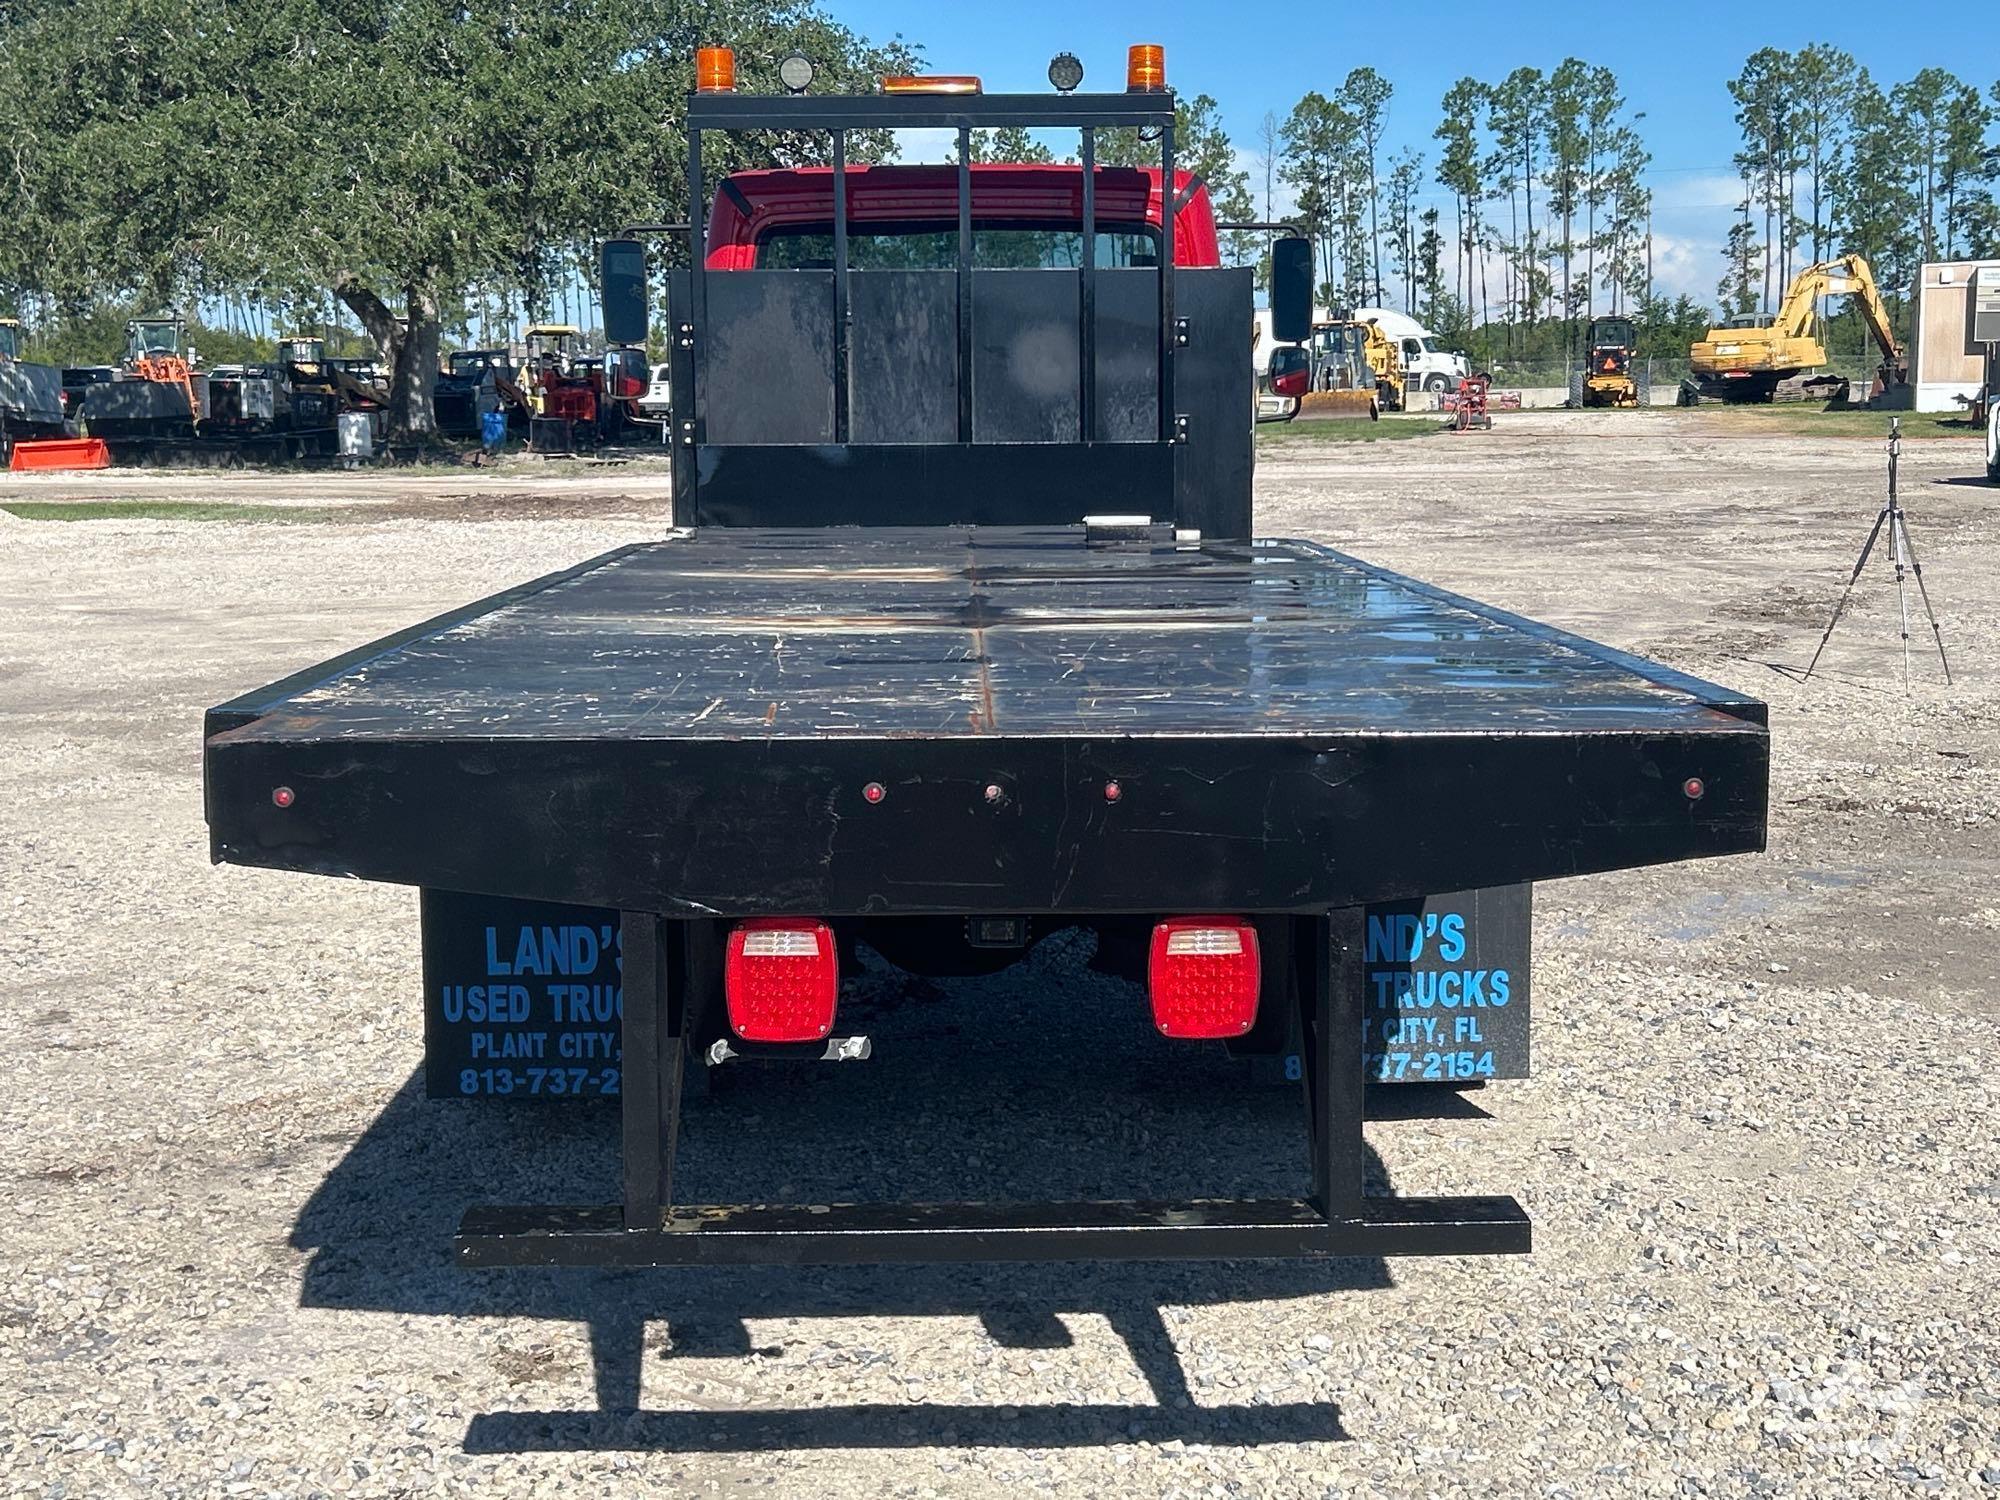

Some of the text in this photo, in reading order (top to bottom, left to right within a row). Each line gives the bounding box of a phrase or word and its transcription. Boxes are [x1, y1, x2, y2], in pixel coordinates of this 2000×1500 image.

[1363, 913, 1466, 963] ND'S
[442, 984, 623, 1024] USED TRU
[1371, 969, 1511, 1009] TRUCKS
[470, 1031, 623, 1062] PLANT CITY,
[1381, 1016, 1446, 1047] CITY,
[1454, 1016, 1484, 1043] FL
[459, 1067, 623, 1095] 813-737-2
